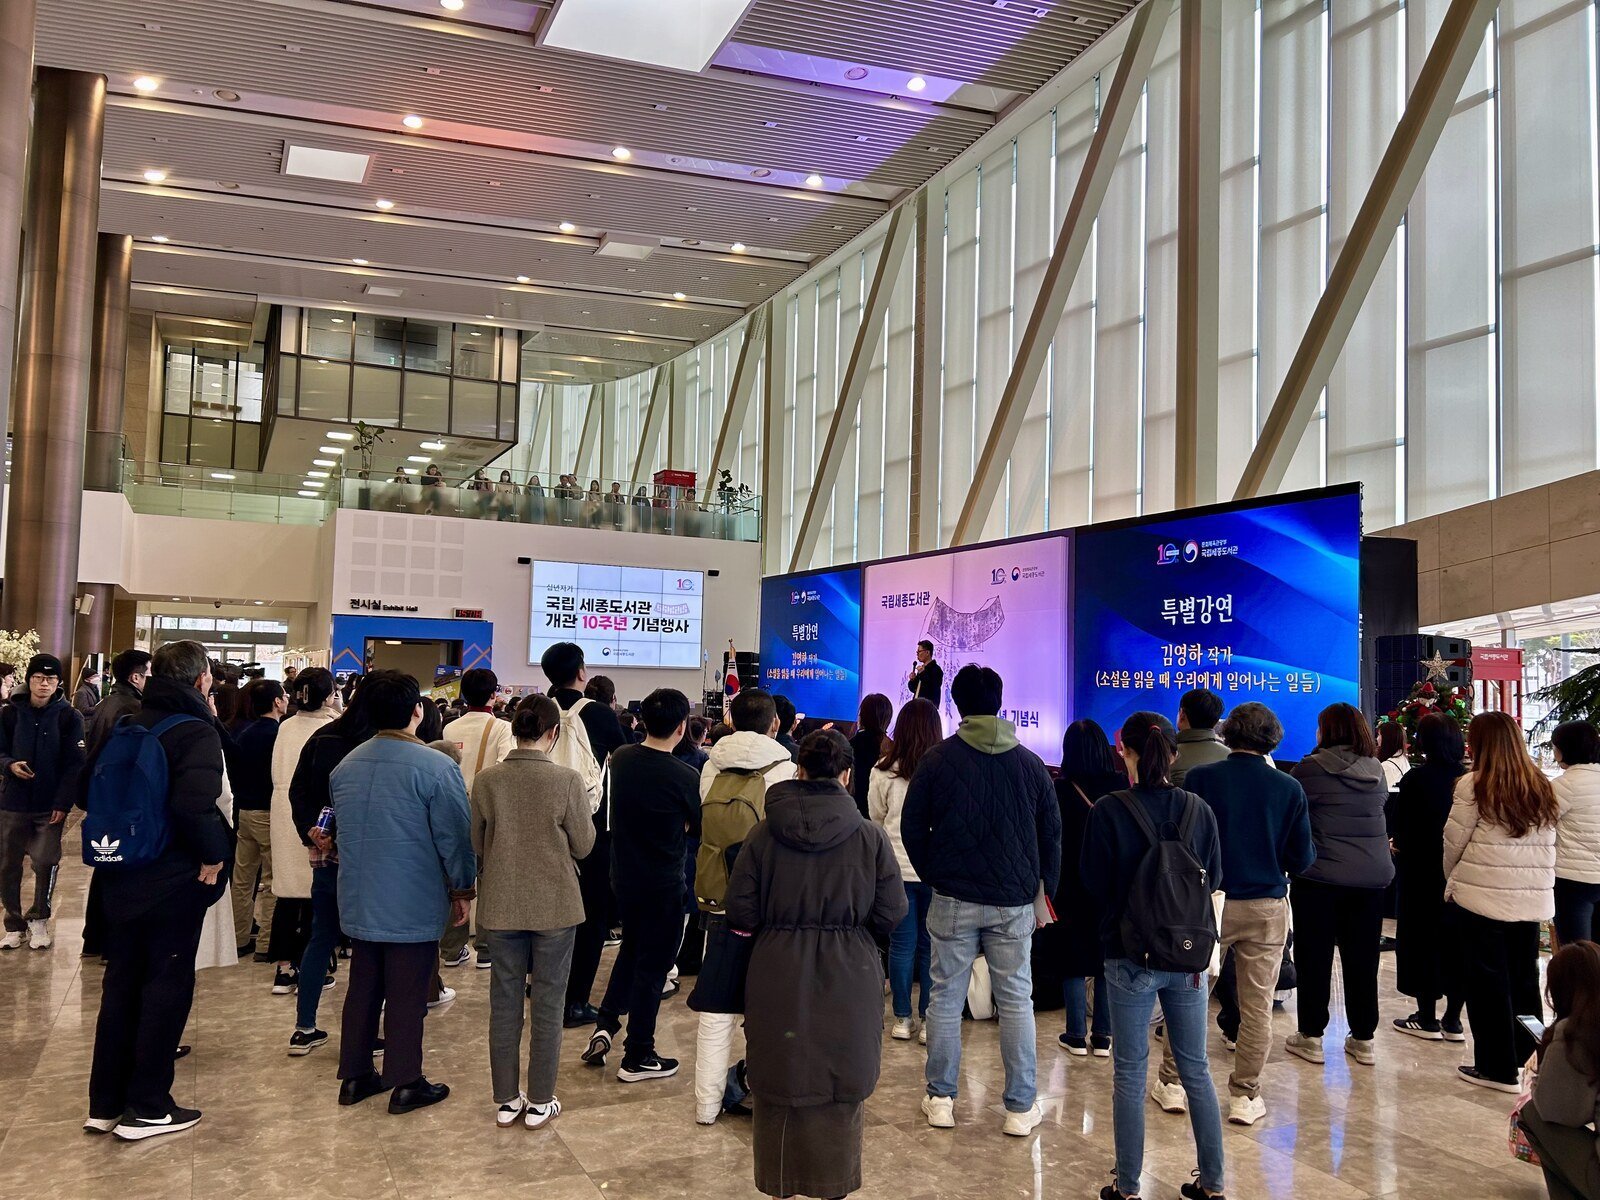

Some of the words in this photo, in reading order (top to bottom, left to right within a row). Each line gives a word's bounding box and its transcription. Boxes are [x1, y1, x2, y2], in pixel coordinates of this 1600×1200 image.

[1201, 545, 1239, 558] 국립세종도서관
[350, 599, 381, 610] 전시실
[546, 595, 575, 611] 국립
[579, 598, 652, 615] 세종도서관
[881, 591, 931, 609] 국립세종도서관
[1161, 594, 1233, 626] 특별강연
[545, 613, 578, 629] 개관
[582, 615, 628, 631] 10주년
[632, 617, 689, 634] 기념행사
[791, 622, 818, 641] 특별강연
[1160, 643, 1203, 667] 김영하
[1207, 645, 1234, 666] 작가
[1095, 670, 1131, 689] (소설을
[1134, 671, 1155, 690] 읽을
[1159, 671, 1170, 690] 때
[1173, 670, 1222, 691] 우리에게
[1227, 671, 1281, 693] 일어나는
[1286, 671, 1321, 693] 일들)
[1011, 709, 1039, 728] 기념식
